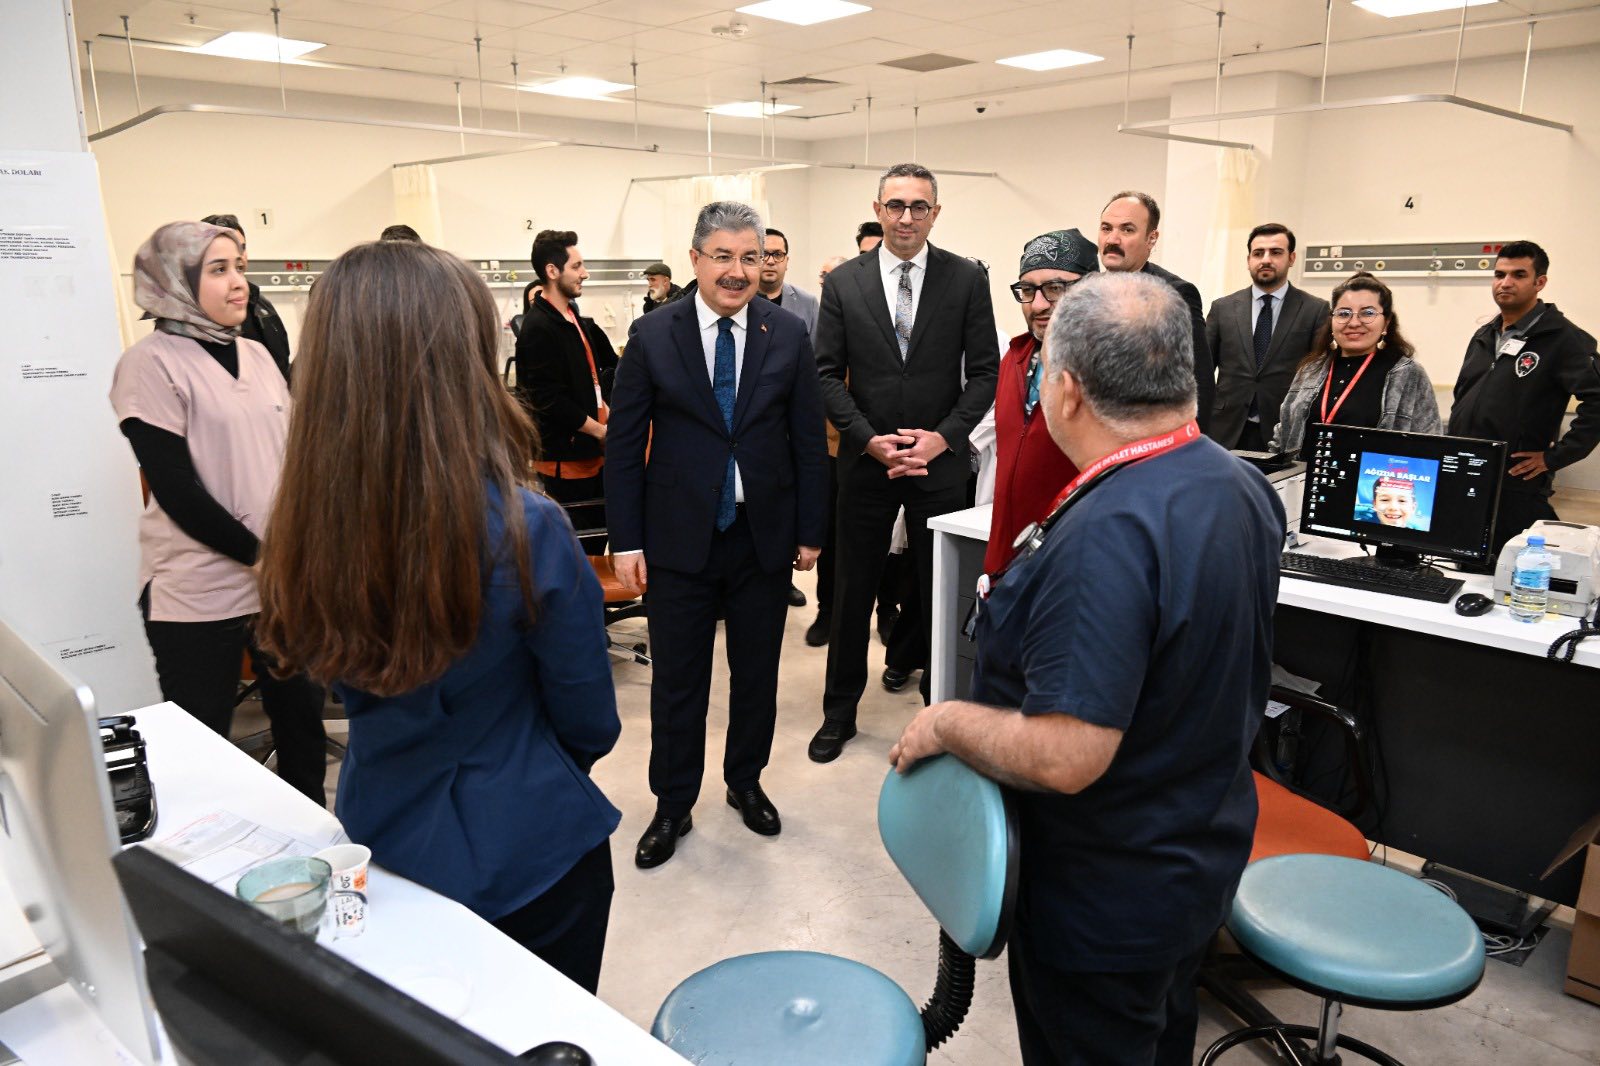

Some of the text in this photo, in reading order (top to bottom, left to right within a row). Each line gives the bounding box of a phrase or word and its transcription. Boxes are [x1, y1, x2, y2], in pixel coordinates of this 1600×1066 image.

[1404, 196, 1414, 209] 4
[260, 212, 267, 225] 1
[526, 219, 533, 230] 2
[1102, 449, 1129, 467] DEVLET
[1130, 436, 1174, 456] HASTANESİ
[1364, 467, 1396, 478] AĞIZDA
[1396, 472, 1431, 483] BAŞLAR
